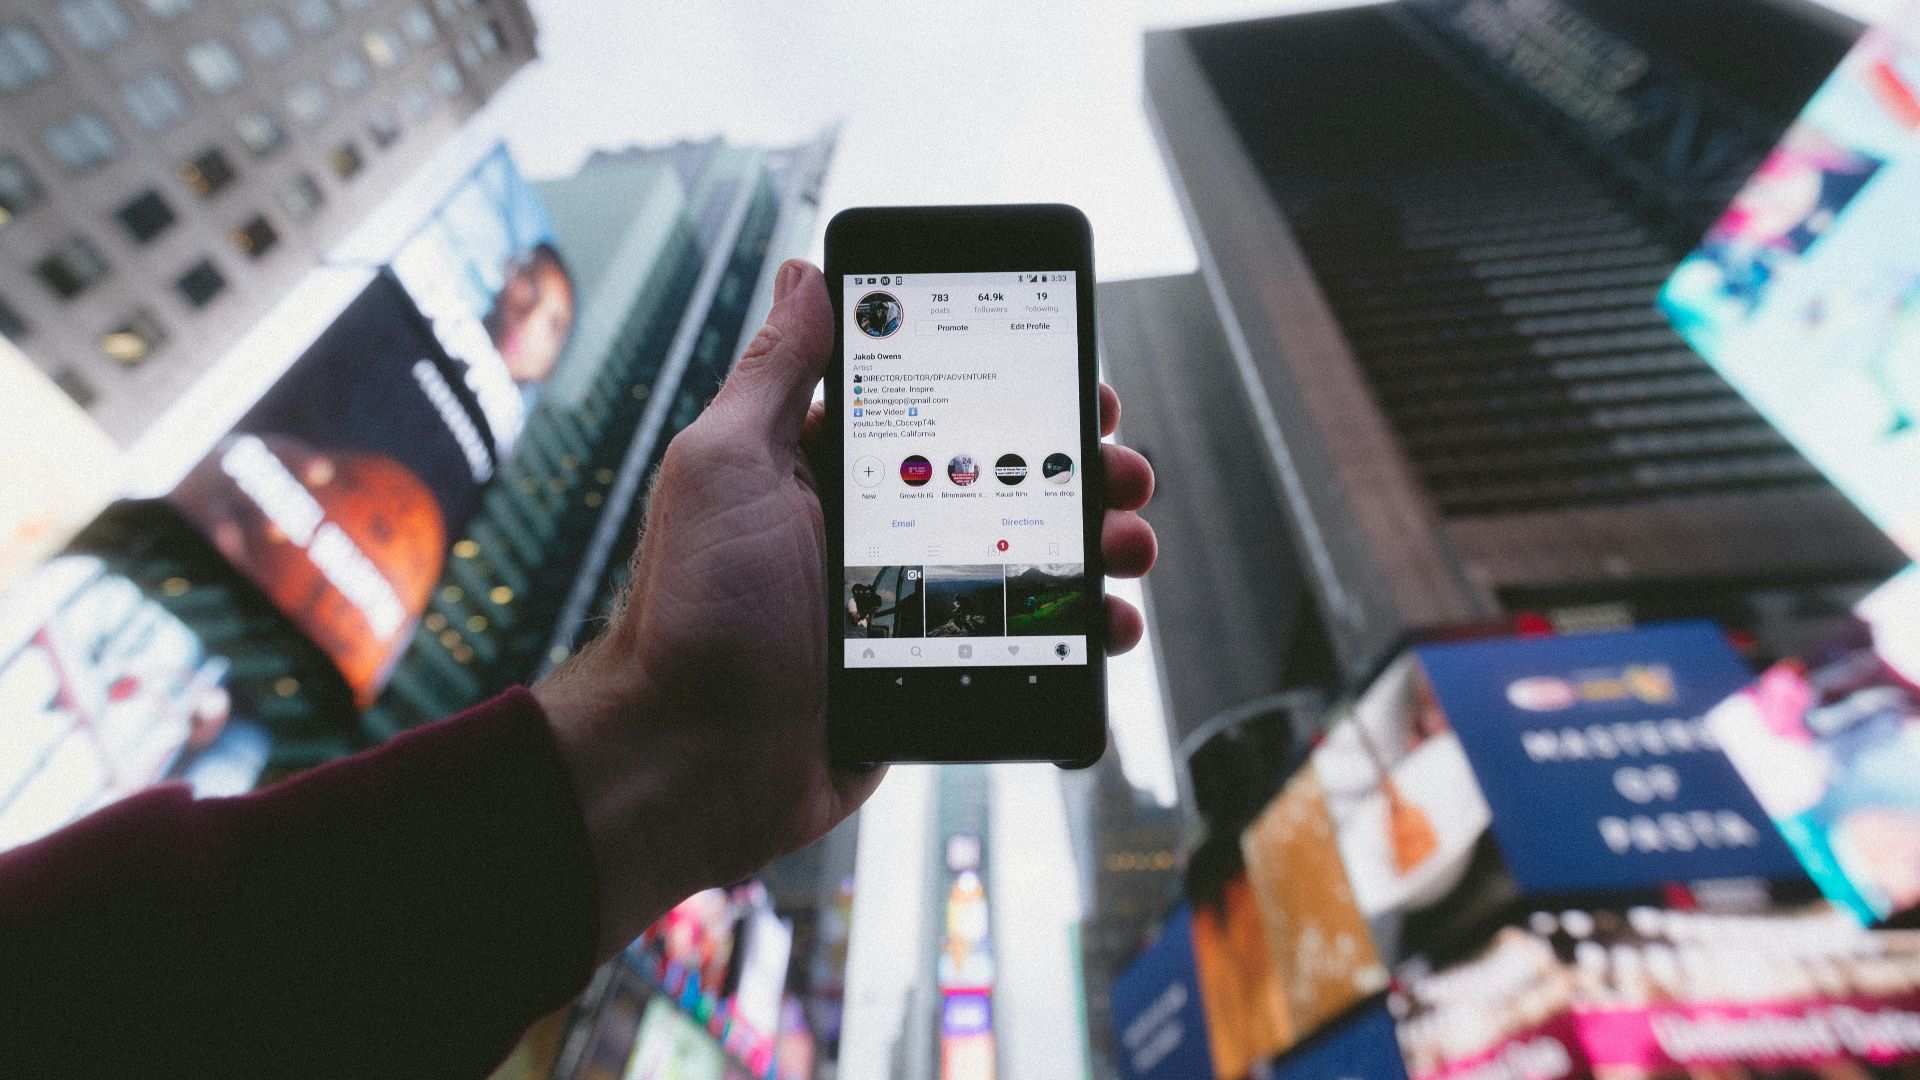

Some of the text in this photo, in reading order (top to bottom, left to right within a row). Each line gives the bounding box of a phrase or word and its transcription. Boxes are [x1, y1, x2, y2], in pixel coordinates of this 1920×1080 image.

[1051, 274, 1067, 282] 3:33
[931, 293, 949, 302] 783
[978, 292, 1004, 302] 64.9k
[1036, 292, 1048, 301] 19
[930, 307, 951, 315] posts
[974, 305, 1008, 313] followers
[1025, 305, 1059, 314] following
[937, 324, 969, 332] Promote
[1010, 322, 1051, 331] Edit Profile
[853, 353, 876, 361] Jakob
[853, 364, 873, 372] Artist
[863, 373, 997, 383] DIRECTOR/EDITOR/DP/ADVENTURER
[900, 430, 936, 438] California
[862, 492, 877, 500] New
[899, 492, 917, 500] Grow
[941, 491, 977, 499] filmmakers
[995, 491, 1013, 499] Kauai
[1059, 490, 1075, 498] drop
[892, 519, 916, 528] Email
[1002, 517, 1044, 526] Directions
